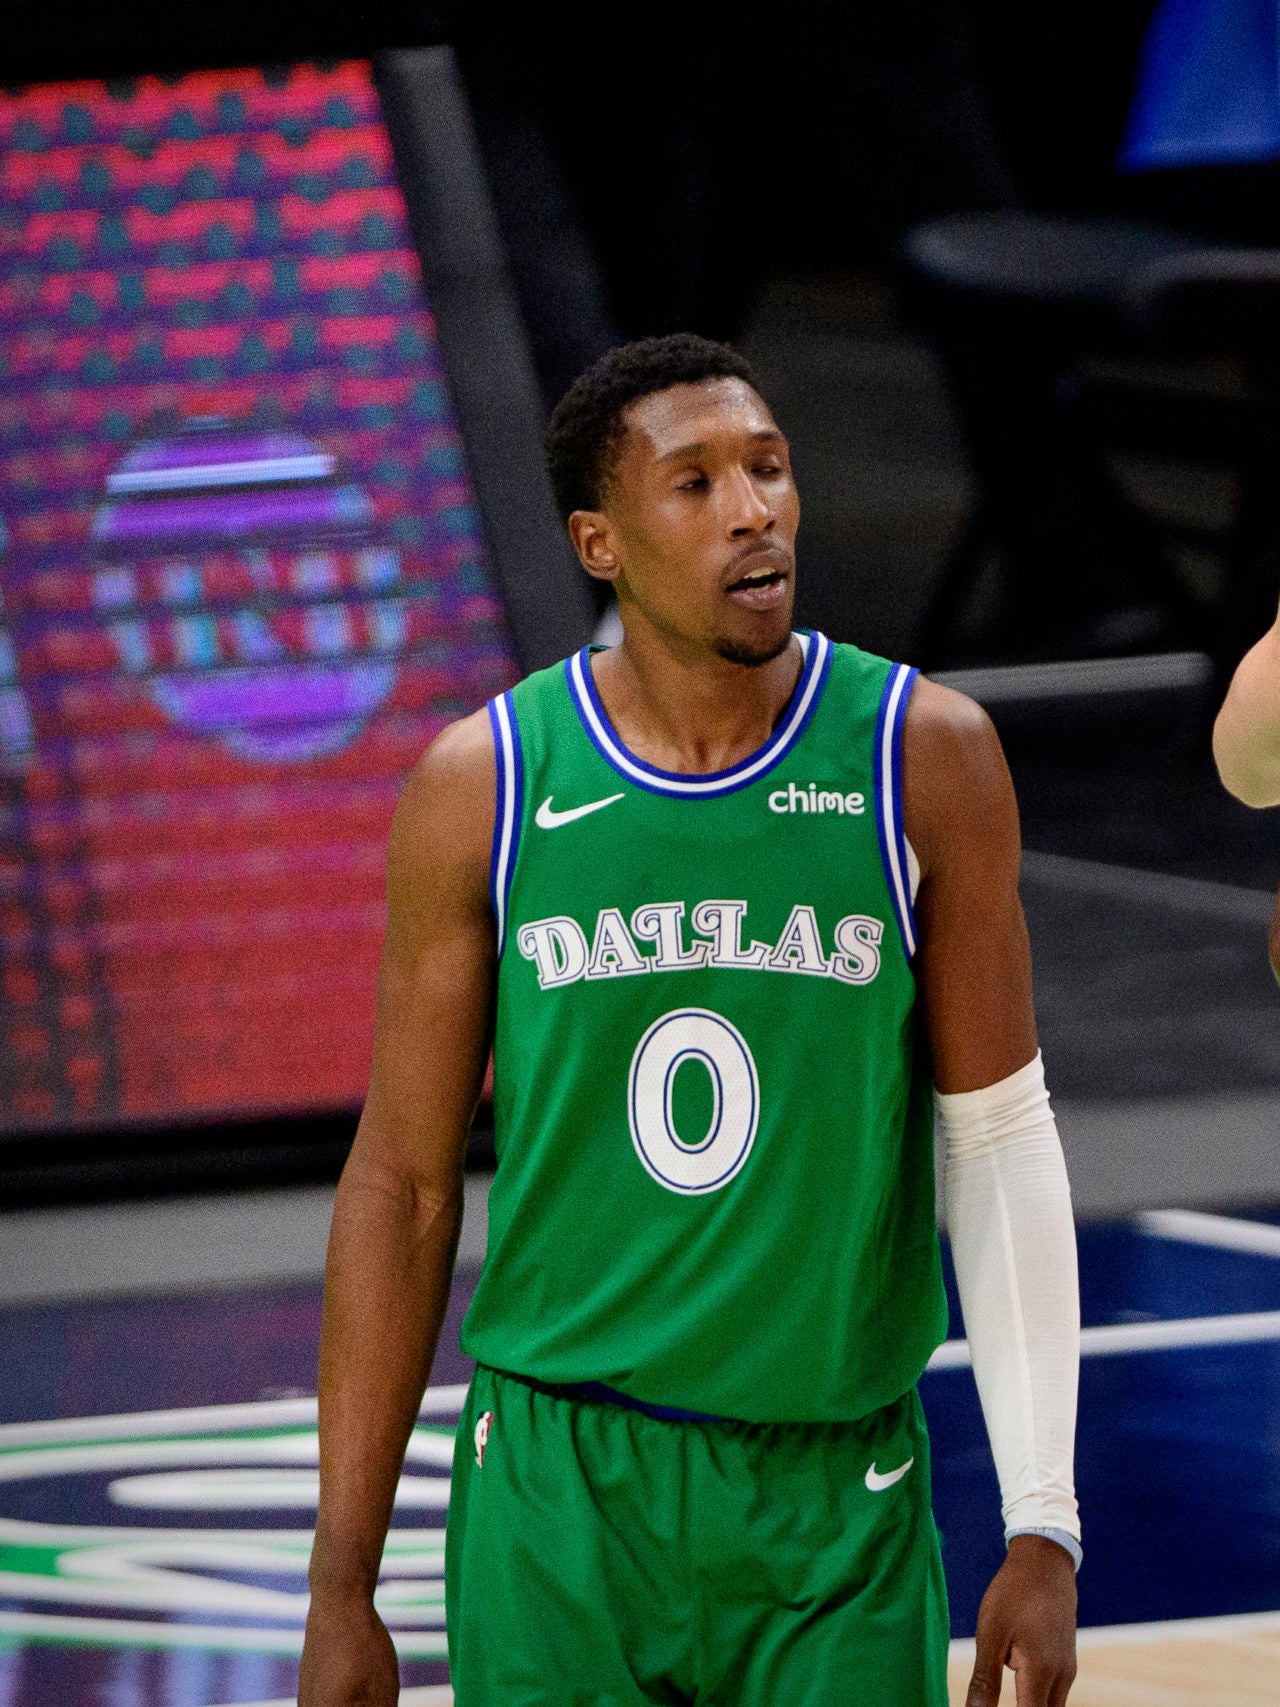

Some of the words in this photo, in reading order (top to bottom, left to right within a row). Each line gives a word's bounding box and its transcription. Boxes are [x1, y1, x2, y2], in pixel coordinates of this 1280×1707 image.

[769, 782, 866, 815] chime
[517, 900, 885, 990] DALLAS
[628, 1007, 760, 1195] 0
